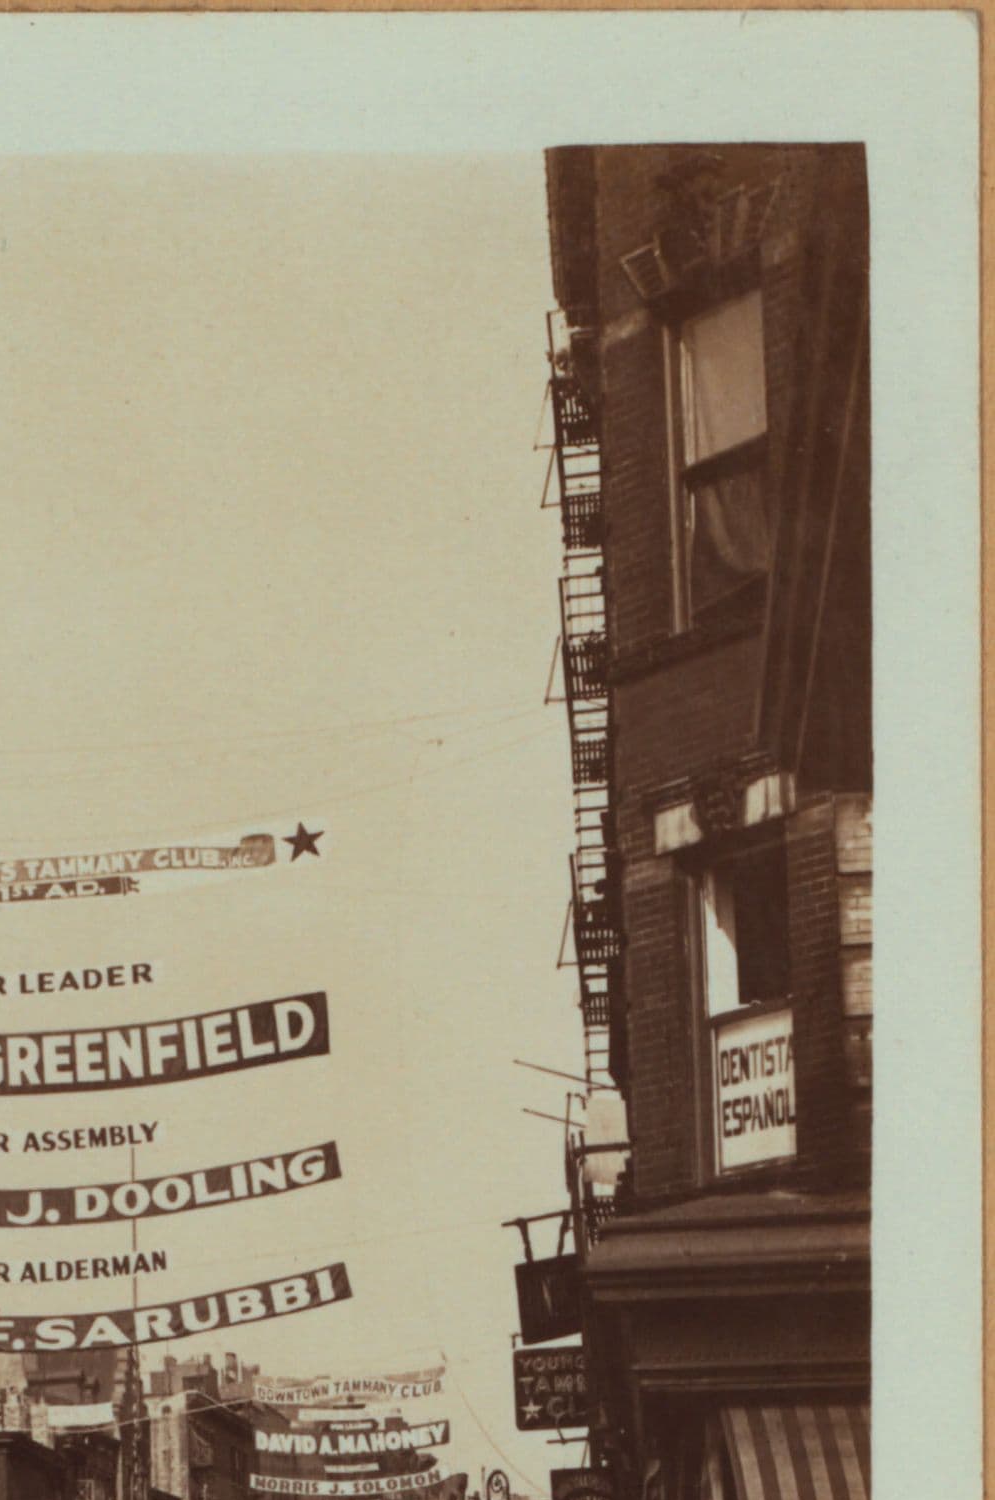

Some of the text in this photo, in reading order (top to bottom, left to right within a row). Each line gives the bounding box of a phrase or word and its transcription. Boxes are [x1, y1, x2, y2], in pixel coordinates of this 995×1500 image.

[24, 851, 142, 880] TAMMANY
[45, 881, 106, 899] A.D.
[19, 963, 154, 995] LEADER
[720, 1032, 793, 1087] DENTISTA
[721, 1085, 796, 1138] ESPAÑOL
[22, 1121, 159, 1153] ASSEMBLY
[6, 1189, 61, 1226] J.
[75, 1148, 326, 1222] DOOLING
[19, 1250, 167, 1284] ALDERMAN
[258, 1379, 442, 1401] DOWNTOWN TAMMANY CLUB
[255, 1430, 317, 1454] DAVID
[254, 1475, 318, 1494] MORRIS
[353, 1470, 441, 1494] SOLOMON
